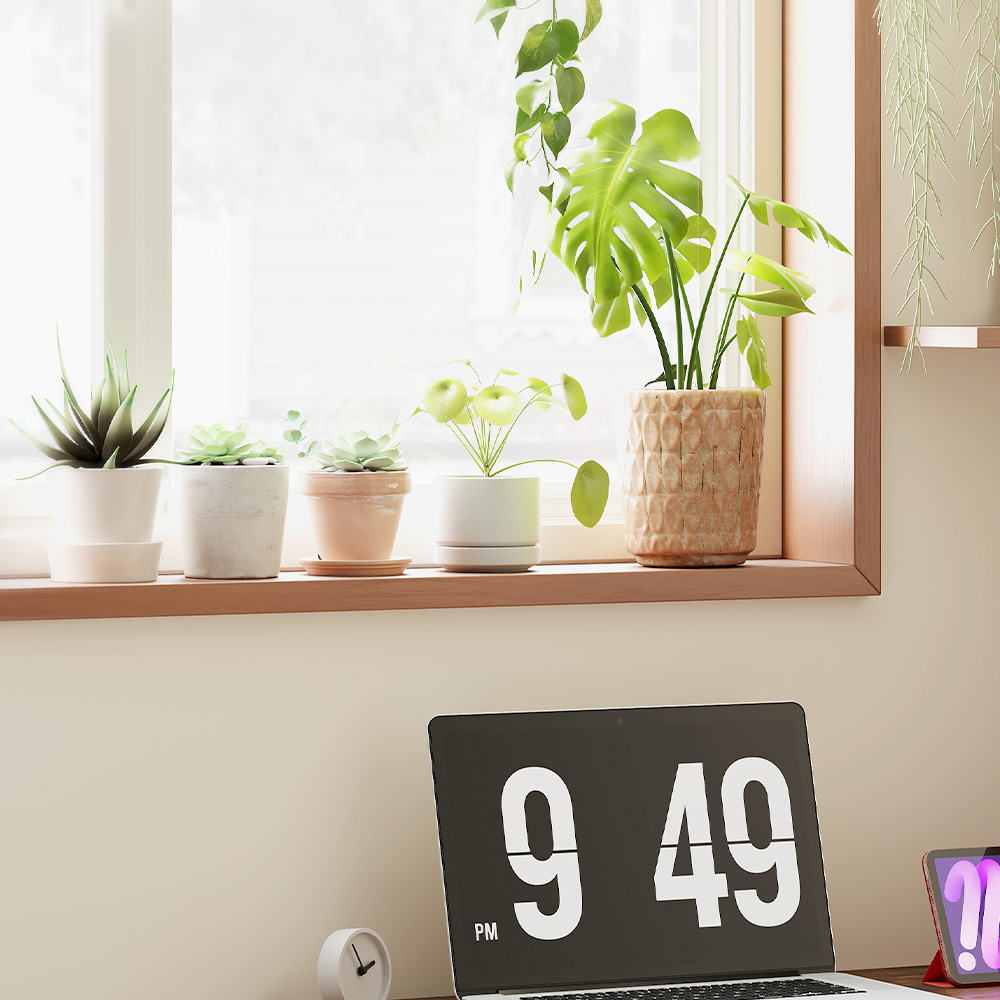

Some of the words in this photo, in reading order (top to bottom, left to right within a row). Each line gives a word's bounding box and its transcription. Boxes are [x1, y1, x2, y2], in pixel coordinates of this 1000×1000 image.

[502, 767, 582, 940] 9
[654, 757, 800, 927] 49
[475, 923, 498, 941] PM
